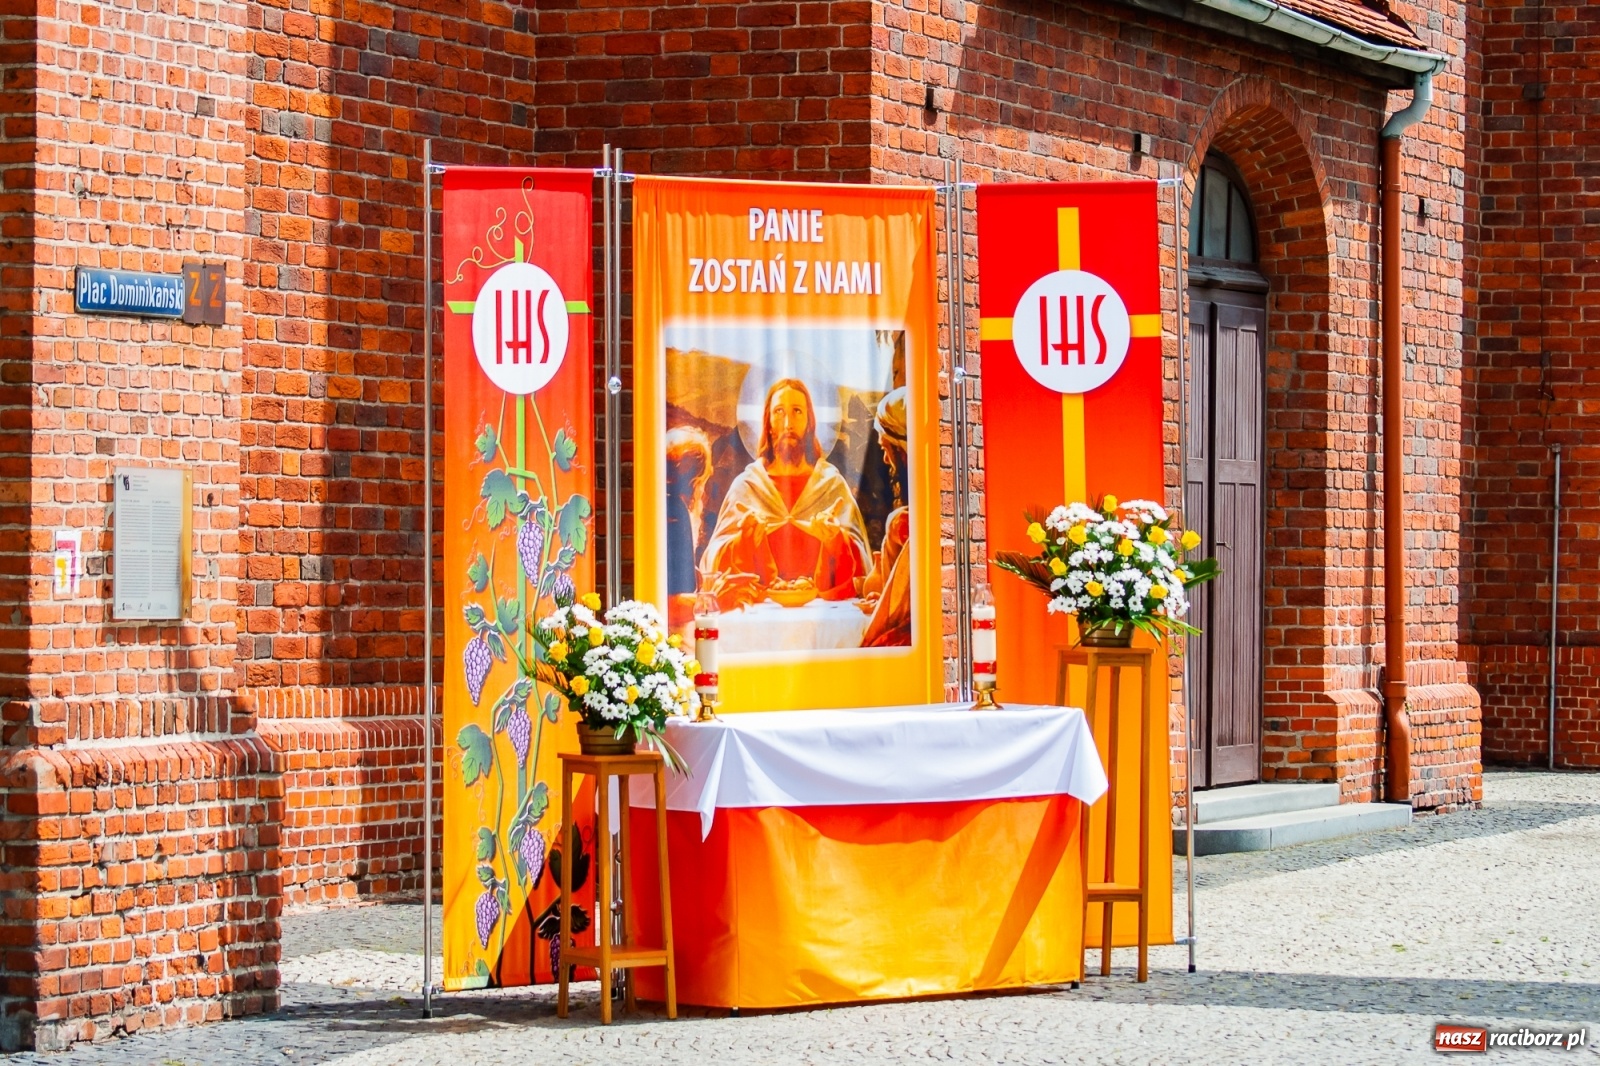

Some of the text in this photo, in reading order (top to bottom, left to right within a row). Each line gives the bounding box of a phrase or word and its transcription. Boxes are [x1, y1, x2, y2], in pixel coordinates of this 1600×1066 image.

[749, 207, 824, 243] PANIE
[80, 272, 184, 310] Plac Dominikański
[688, 253, 882, 295] ZOSTAŃ Z NAMI
[495, 289, 550, 364] IHS
[1039, 294, 1107, 365] IHS
